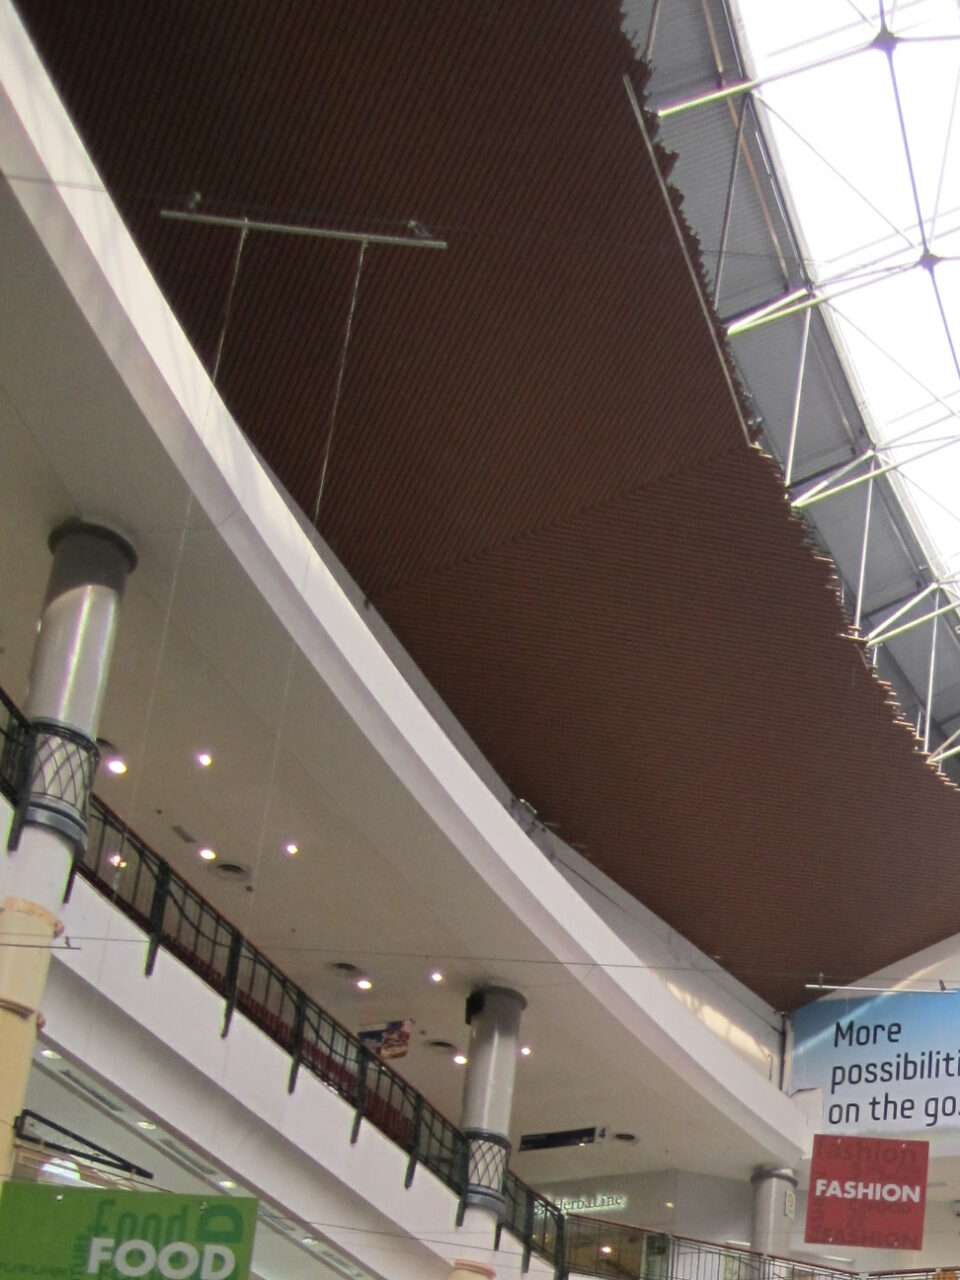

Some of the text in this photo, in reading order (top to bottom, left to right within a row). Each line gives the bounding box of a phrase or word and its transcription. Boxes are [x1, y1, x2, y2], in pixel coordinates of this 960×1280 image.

[834, 1020, 902, 1048] More
[828, 1103, 860, 1124] on
[869, 1092, 915, 1121] the
[815, 1179, 921, 1203] FASHION
